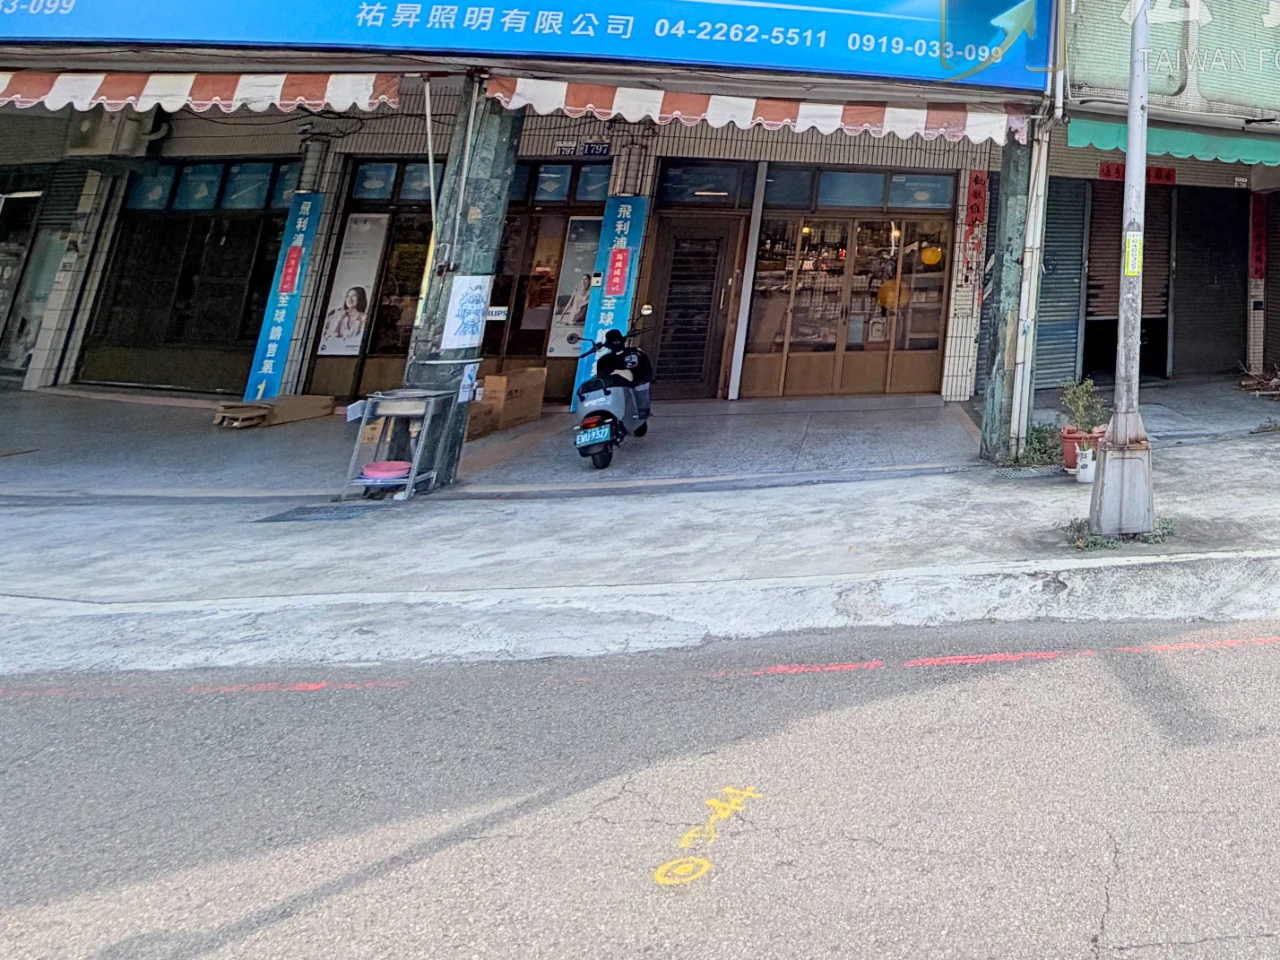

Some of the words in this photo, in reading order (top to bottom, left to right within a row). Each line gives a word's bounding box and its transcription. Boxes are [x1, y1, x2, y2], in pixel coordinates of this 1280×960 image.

[356, 2, 634, 39] 祐昇照明有限公司
[654, 18, 827, 48] 04-2262-5511
[847, 33, 1003, 63] 0919-033-099
[584, 144, 609, 154] 1797
[292, 201, 312, 248] 飛利浦
[613, 204, 632, 249] 飛利浦
